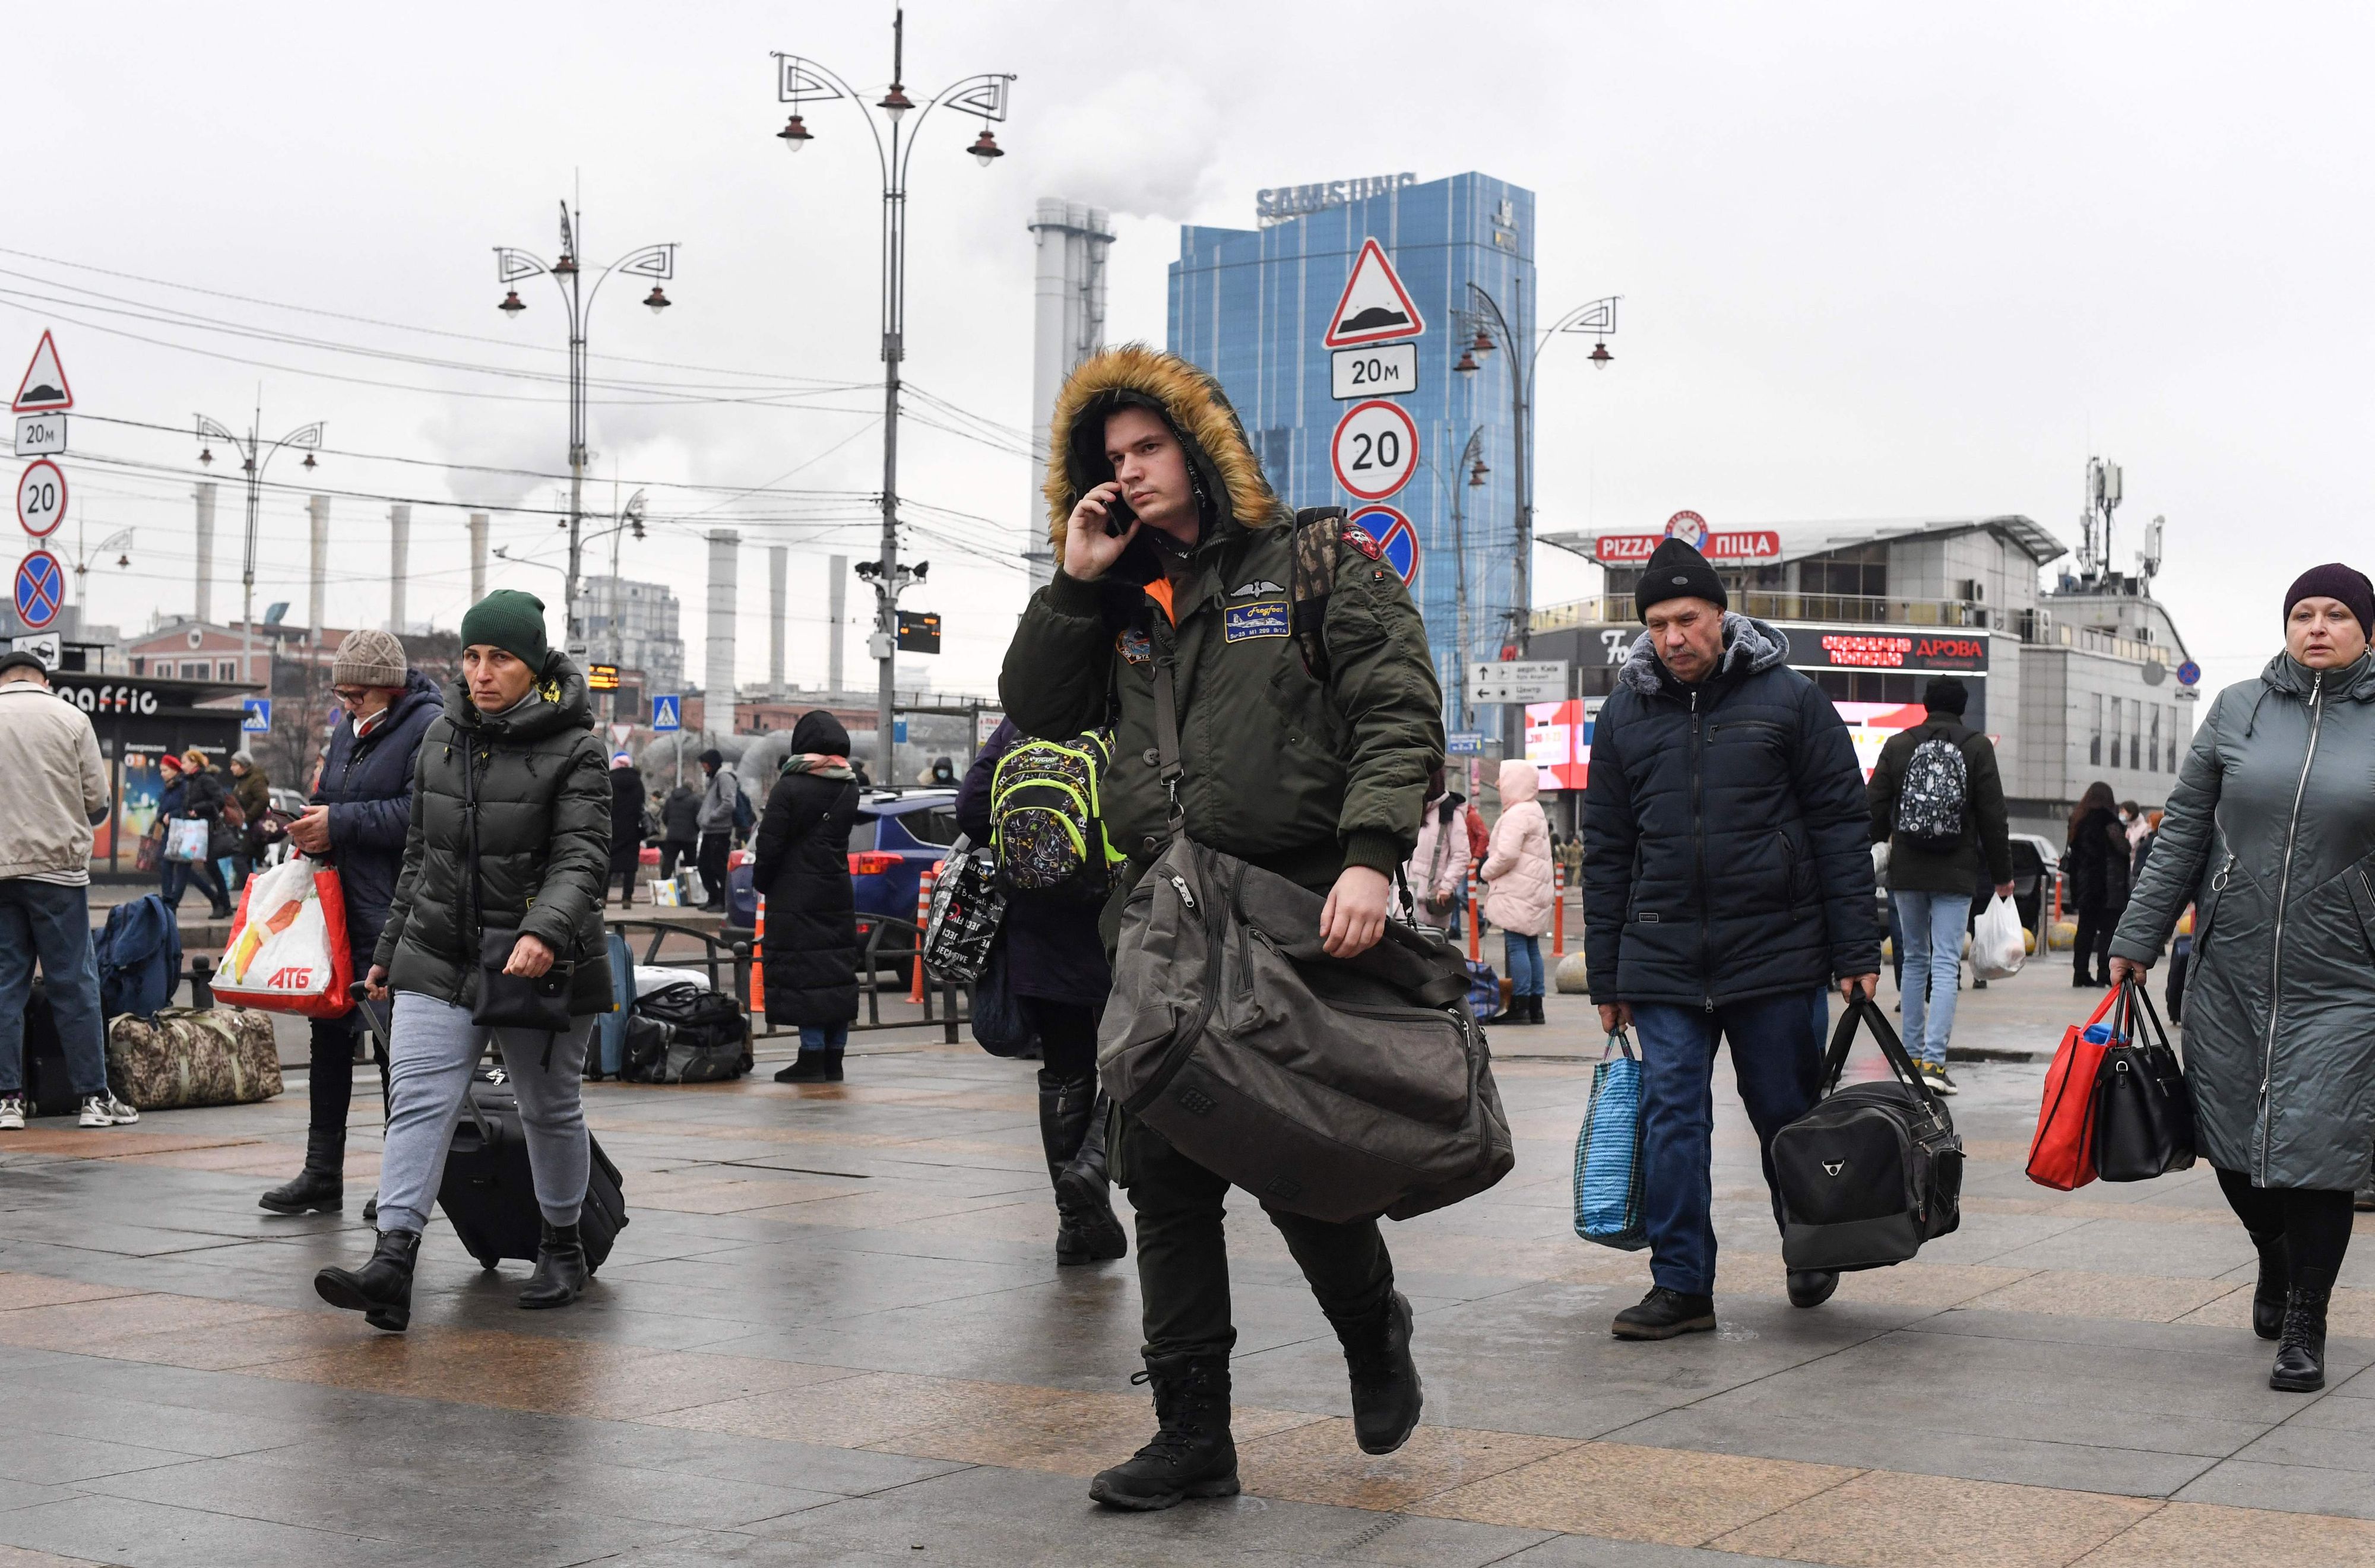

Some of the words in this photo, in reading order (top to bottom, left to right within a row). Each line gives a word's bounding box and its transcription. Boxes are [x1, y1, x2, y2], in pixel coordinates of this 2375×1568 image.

[1353, 430, 1399, 470] 20
[27, 483, 54, 514] 20
[1603, 538, 1655, 556] PIZZA
[1716, 535, 1771, 556] ПІЦА
[1247, 606, 1283, 617] Frogfoot
[942, 928, 958, 940] JECI
